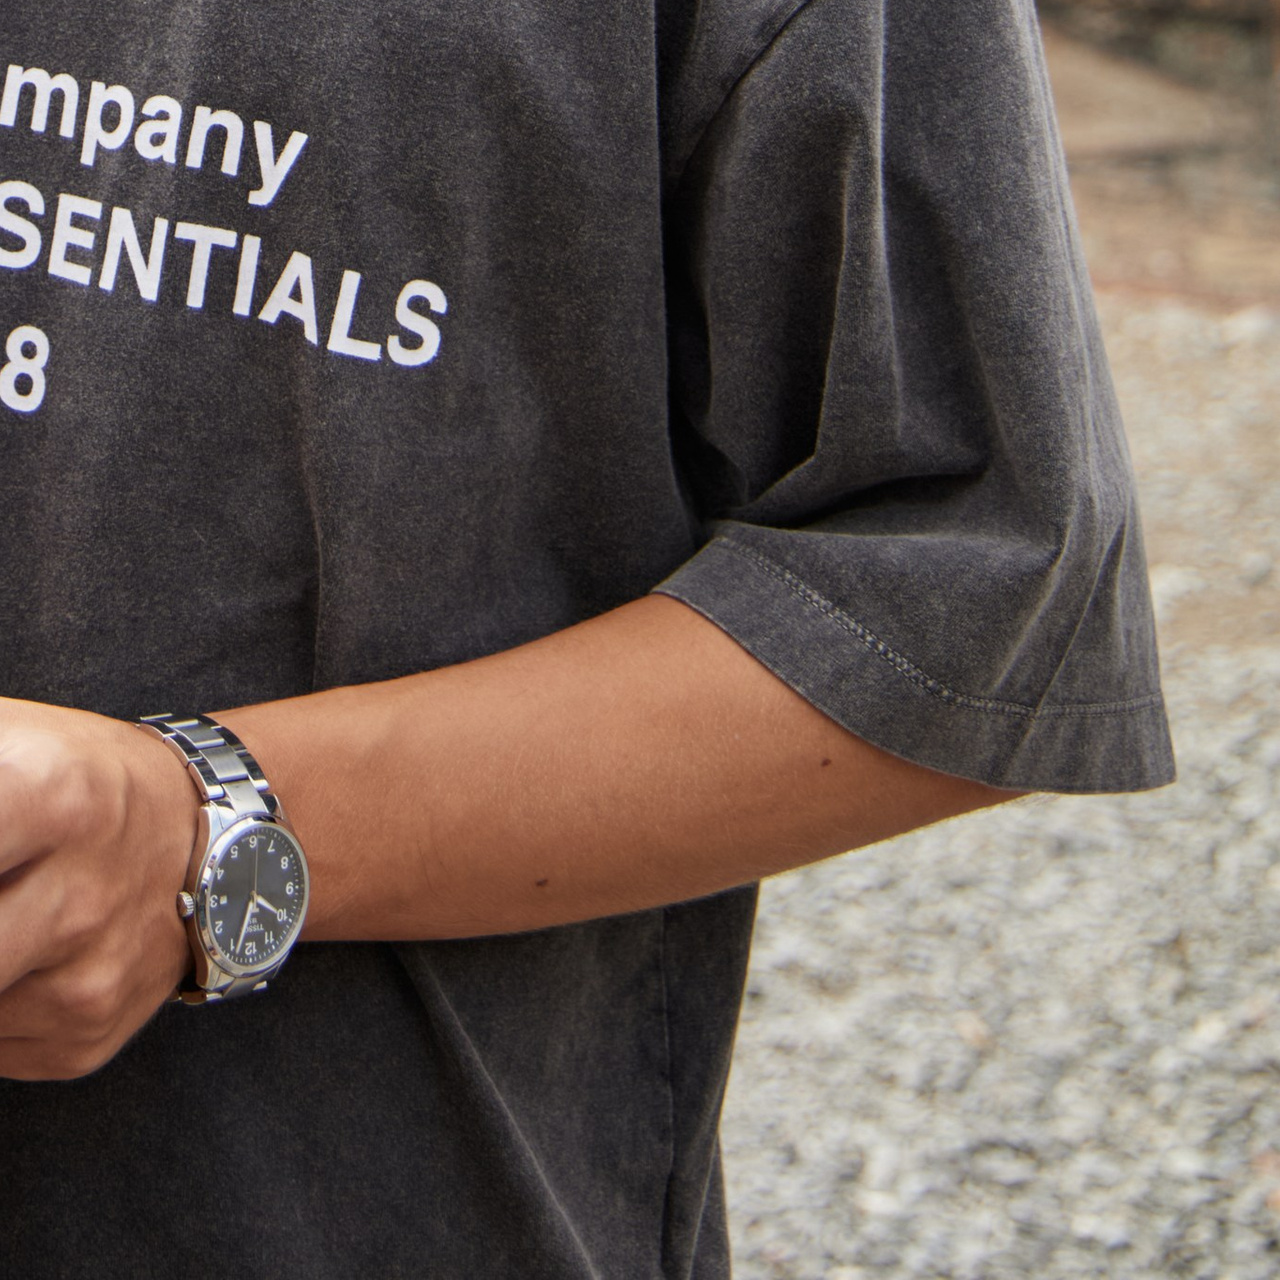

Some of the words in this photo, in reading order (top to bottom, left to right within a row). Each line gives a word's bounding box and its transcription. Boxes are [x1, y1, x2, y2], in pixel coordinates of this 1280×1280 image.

[249, 835, 257, 848] 6
[267, 839, 275, 852] 7
[230, 845, 238, 858] 5
[280, 856, 289, 869] 8
[216, 867, 224, 880] 4
[285, 881, 294, 895] 9
[210, 895, 218, 908] 3
[277, 908, 288, 922] 10
[215, 921, 223, 934] 2
[264, 930, 275, 945] 11
[230, 938, 235, 952] 1
[244, 942, 257, 955] 12
